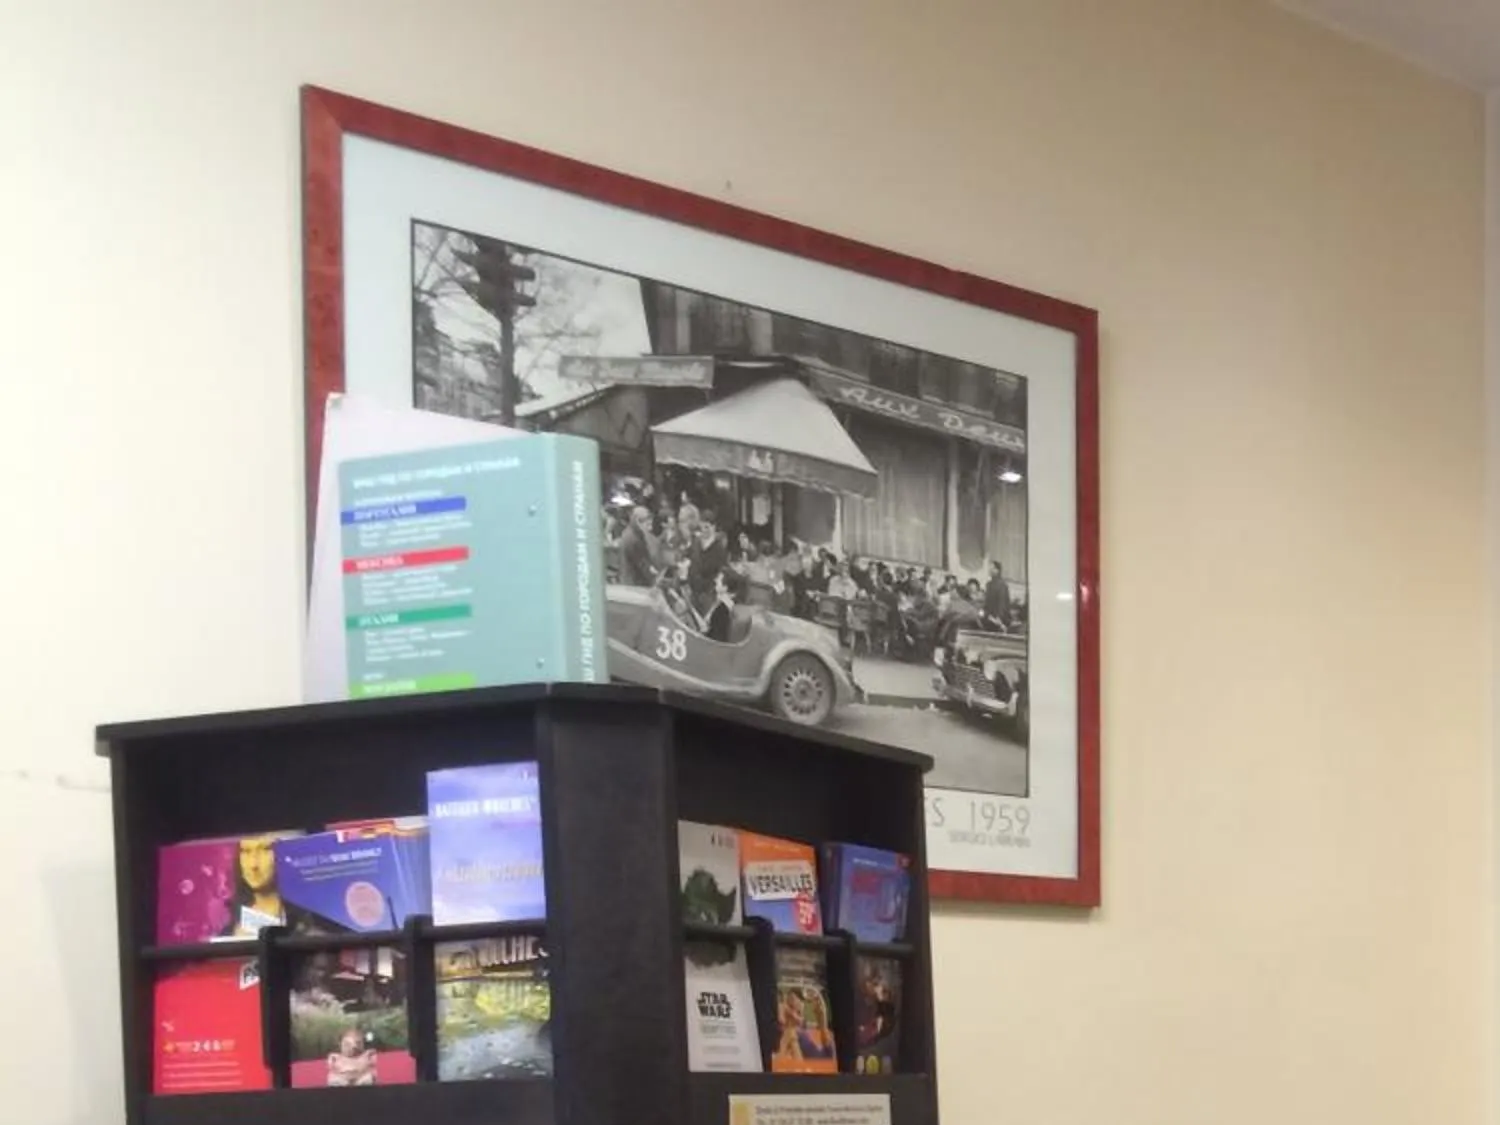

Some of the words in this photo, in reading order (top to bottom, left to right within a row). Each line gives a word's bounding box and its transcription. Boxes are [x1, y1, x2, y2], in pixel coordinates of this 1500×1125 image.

[656, 627, 687, 662] 38
[970, 800, 1031, 836] 1959
[749, 873, 814, 896] VERSAILLES
[697, 991, 731, 1006] STAR
[698, 1003, 733, 1019] WARS
